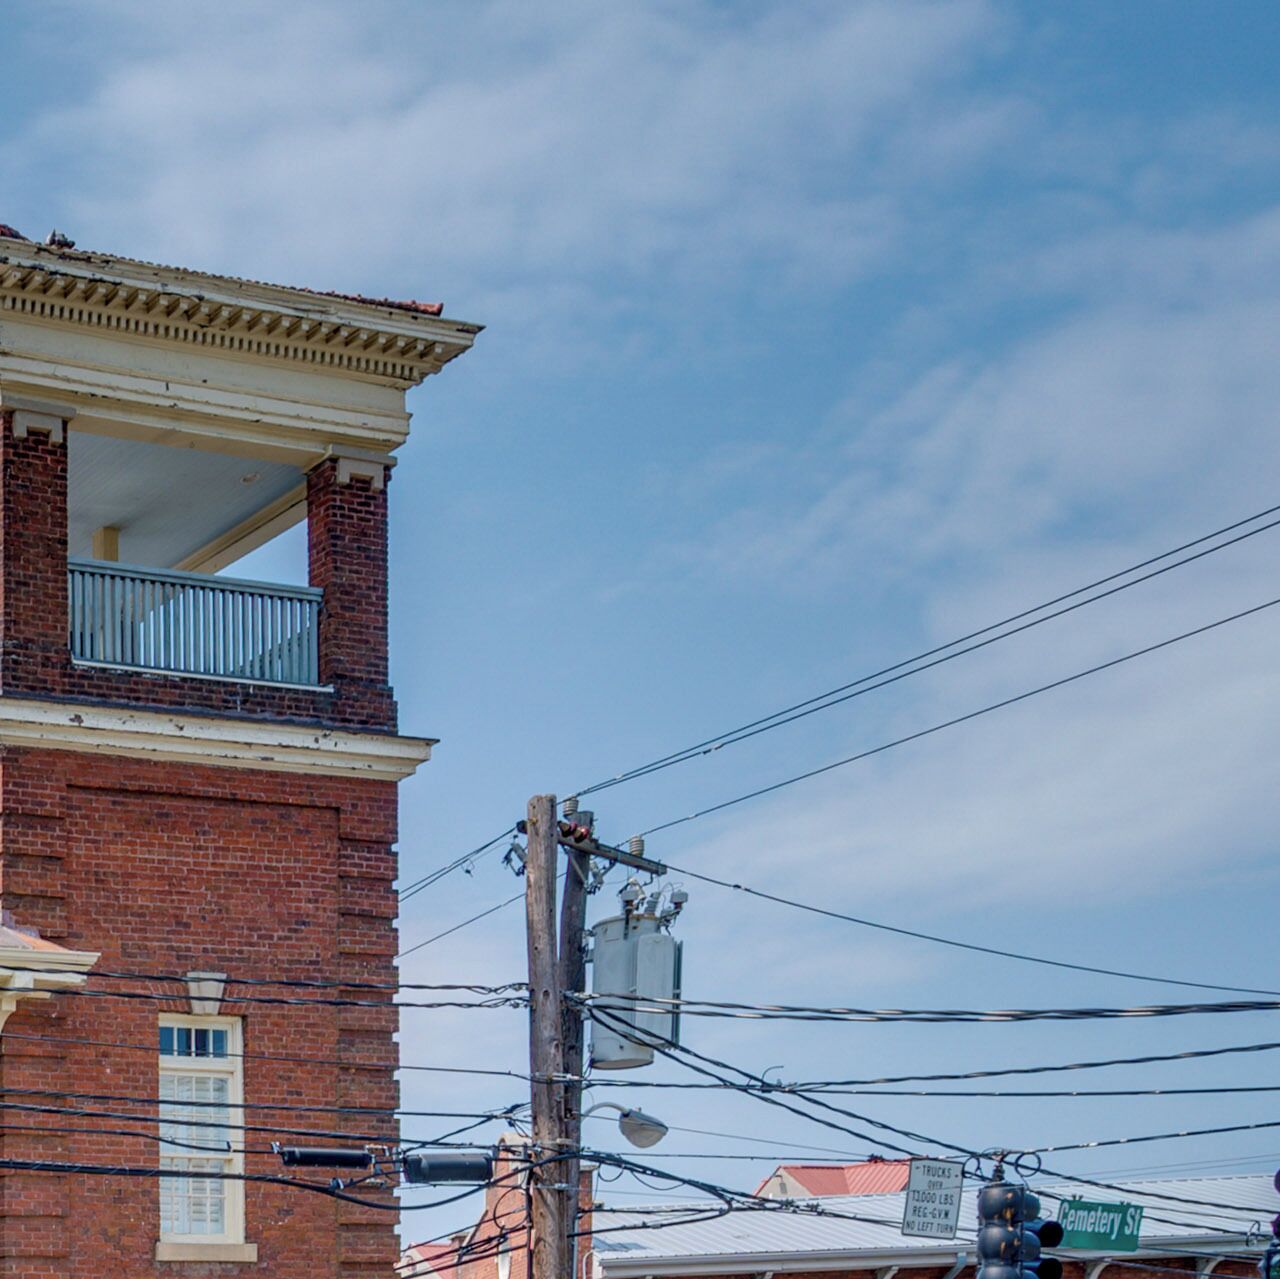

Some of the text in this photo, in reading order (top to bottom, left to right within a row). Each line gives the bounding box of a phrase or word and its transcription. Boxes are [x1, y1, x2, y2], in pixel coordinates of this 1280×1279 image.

[922, 1165, 952, 1179] TRUCKS
[927, 1180, 943, 1191] OVER
[906, 1220, 954, 1233] NO LEFT TURN
[1059, 1202, 1141, 1240] Cemetery St
